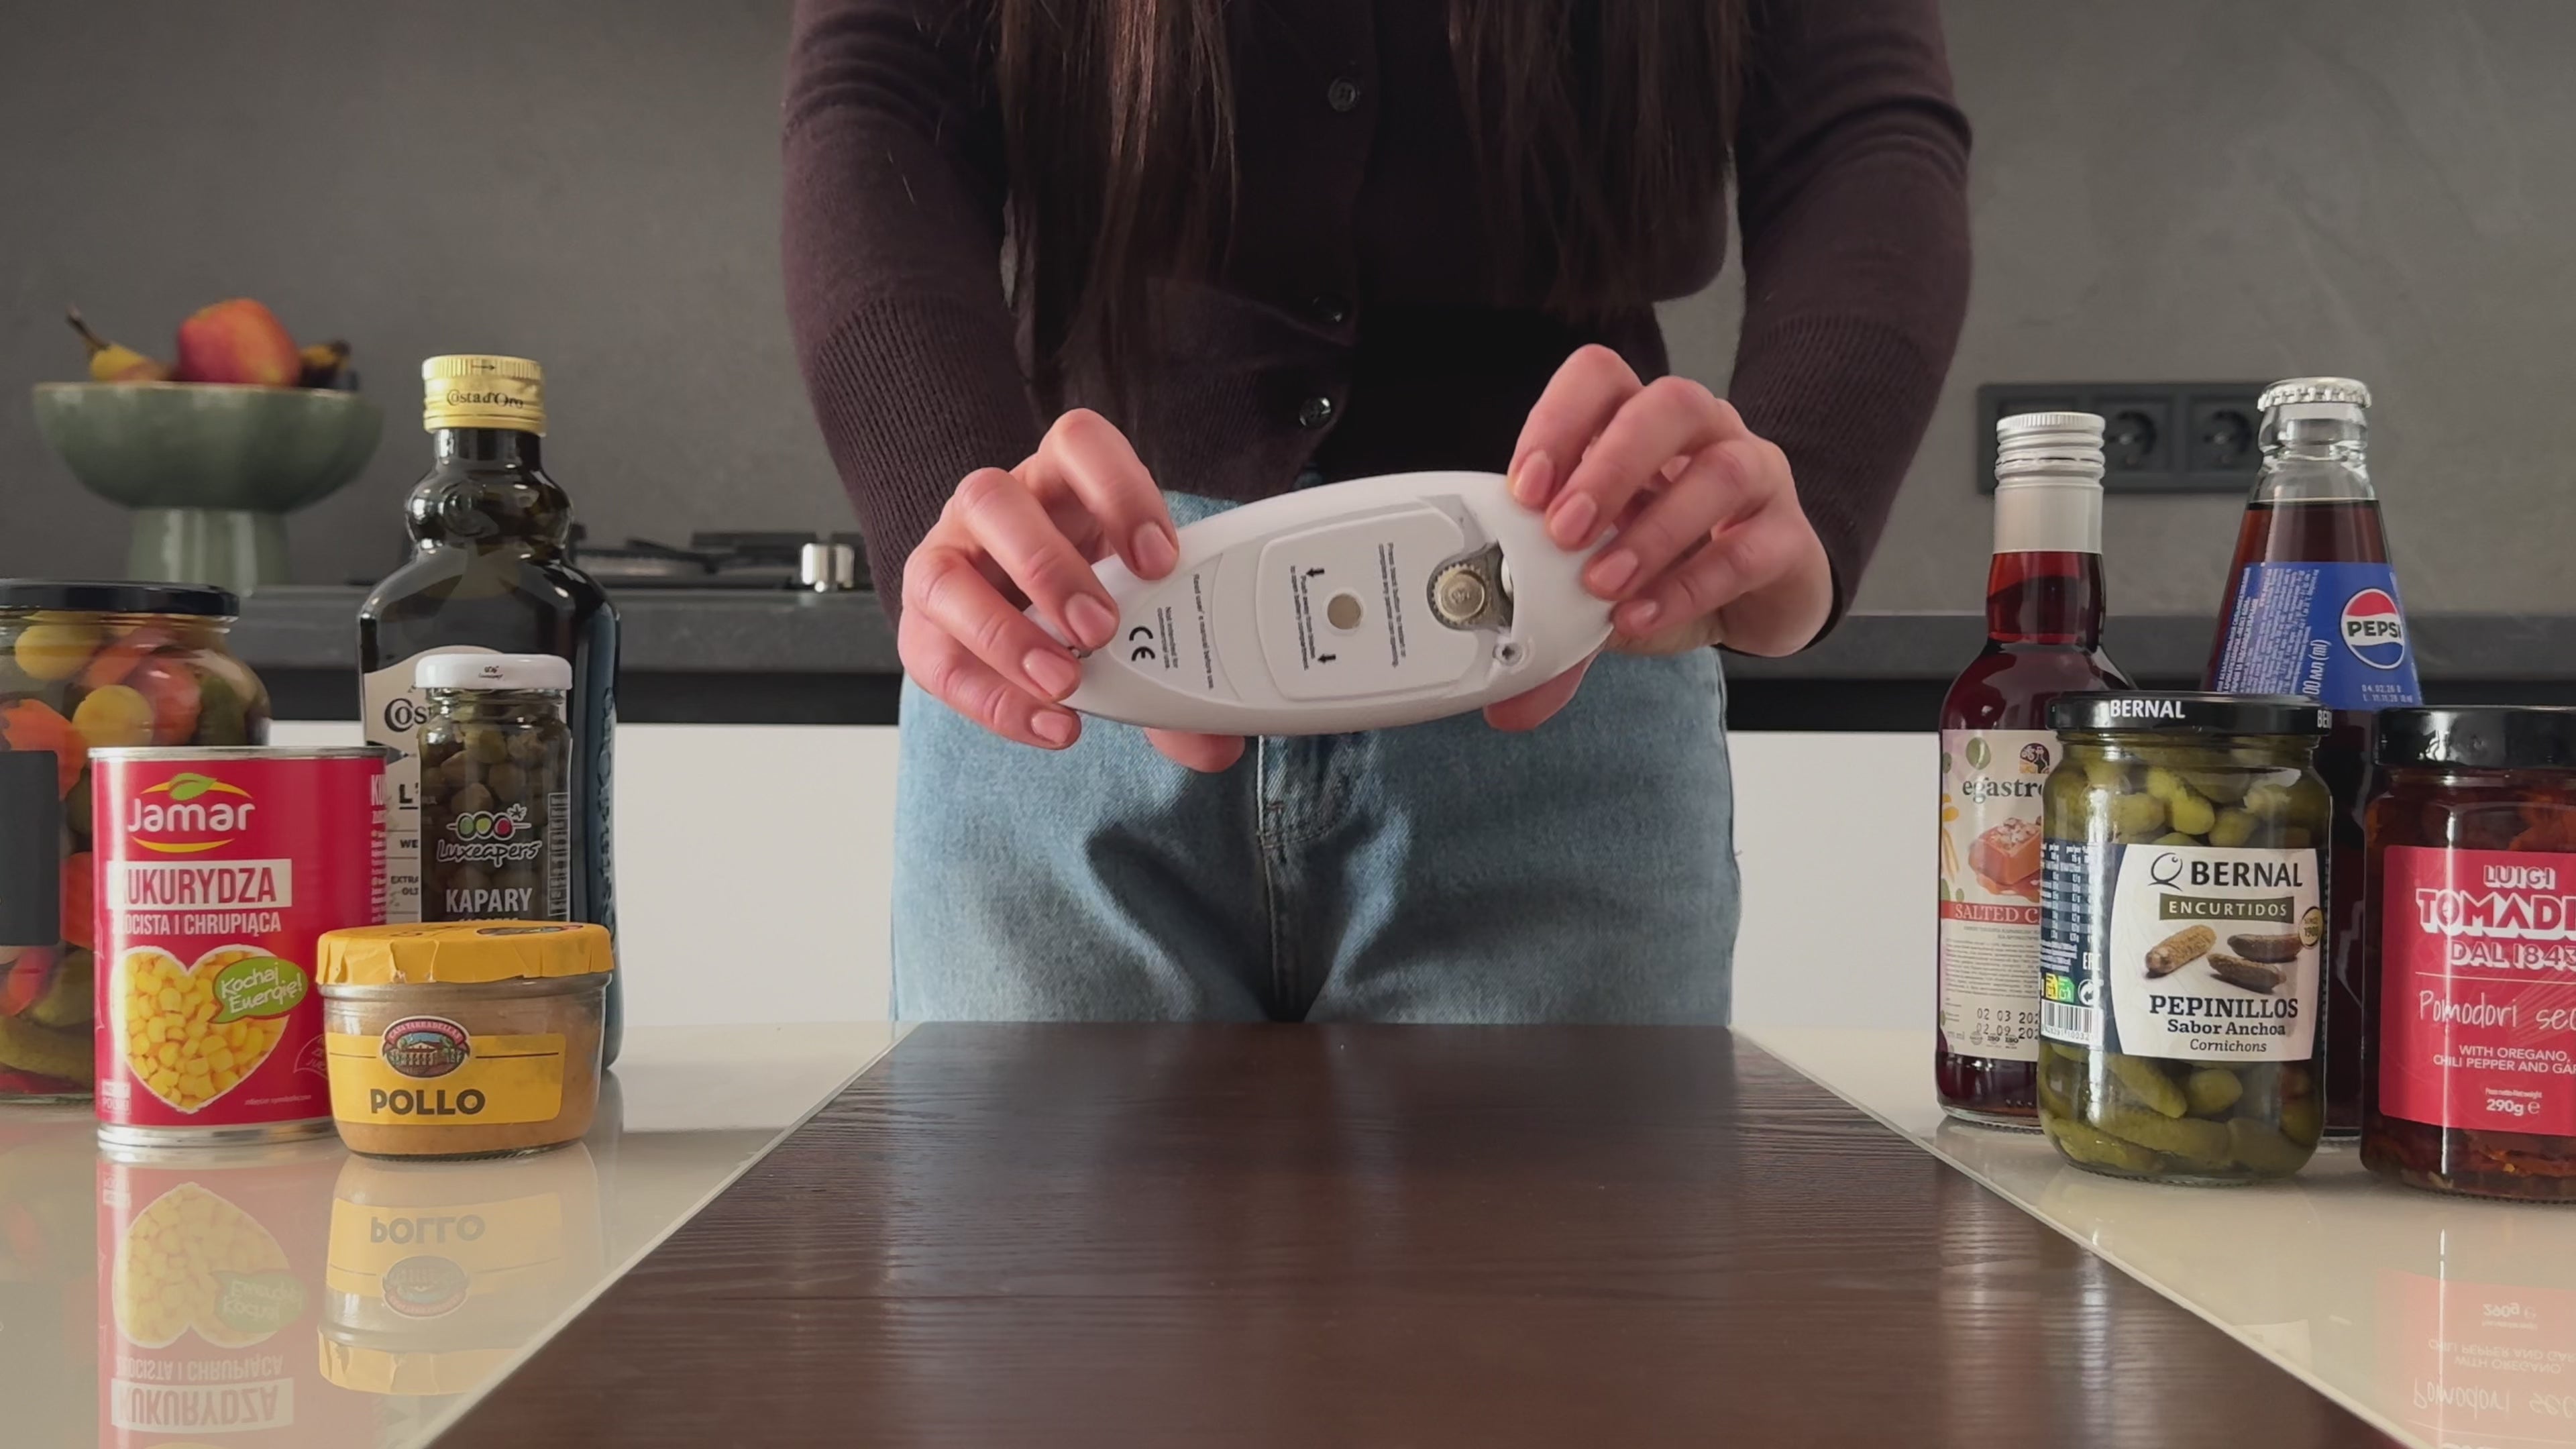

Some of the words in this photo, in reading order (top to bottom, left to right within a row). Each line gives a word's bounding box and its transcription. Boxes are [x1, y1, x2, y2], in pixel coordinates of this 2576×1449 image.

[2347, 621, 2402, 639] PEPSI
[2110, 700, 2186, 719] BERNAL
[127, 798, 256, 832] Jamar
[436, 839, 542, 868] Luxeapers
[123, 867, 277, 904] UKURYDZA
[2190, 861, 2303, 888] BERNAL
[2483, 865, 2556, 890] LUIGI
[445, 888, 533, 913] KAPARY
[2169, 901, 2287, 916] ENCURTIDOS
[113, 914, 168, 935] OCISTA
[184, 912, 282, 936] CHRUPIĄCA
[1955, 904, 2019, 922] SALTED
[2451, 941, 2510, 968] DAL
[221, 962, 279, 999] Kochaj
[1977, 1008, 1990, 1020] 02
[1996, 1010, 2011, 1022] 03
[2149, 994, 2298, 1018] PEPINILLOS
[2419, 990, 2516, 1028] Pomodori
[2167, 1019, 2222, 1034] Sabor
[2225, 1022, 2286, 1036] Anchoa
[2190, 1038, 2267, 1053] Cornichons
[2459, 1044, 2493, 1057] WITH
[2498, 1047, 2571, 1063] OREGANO,
[2433, 1055, 2462, 1067] CHILI
[2466, 1058, 2515, 1071] PEPPER
[2518, 1062, 2548, 1073] AND
[370, 1088, 486, 1116] POLLO
[2486, 1099, 2524, 1116] 290g
